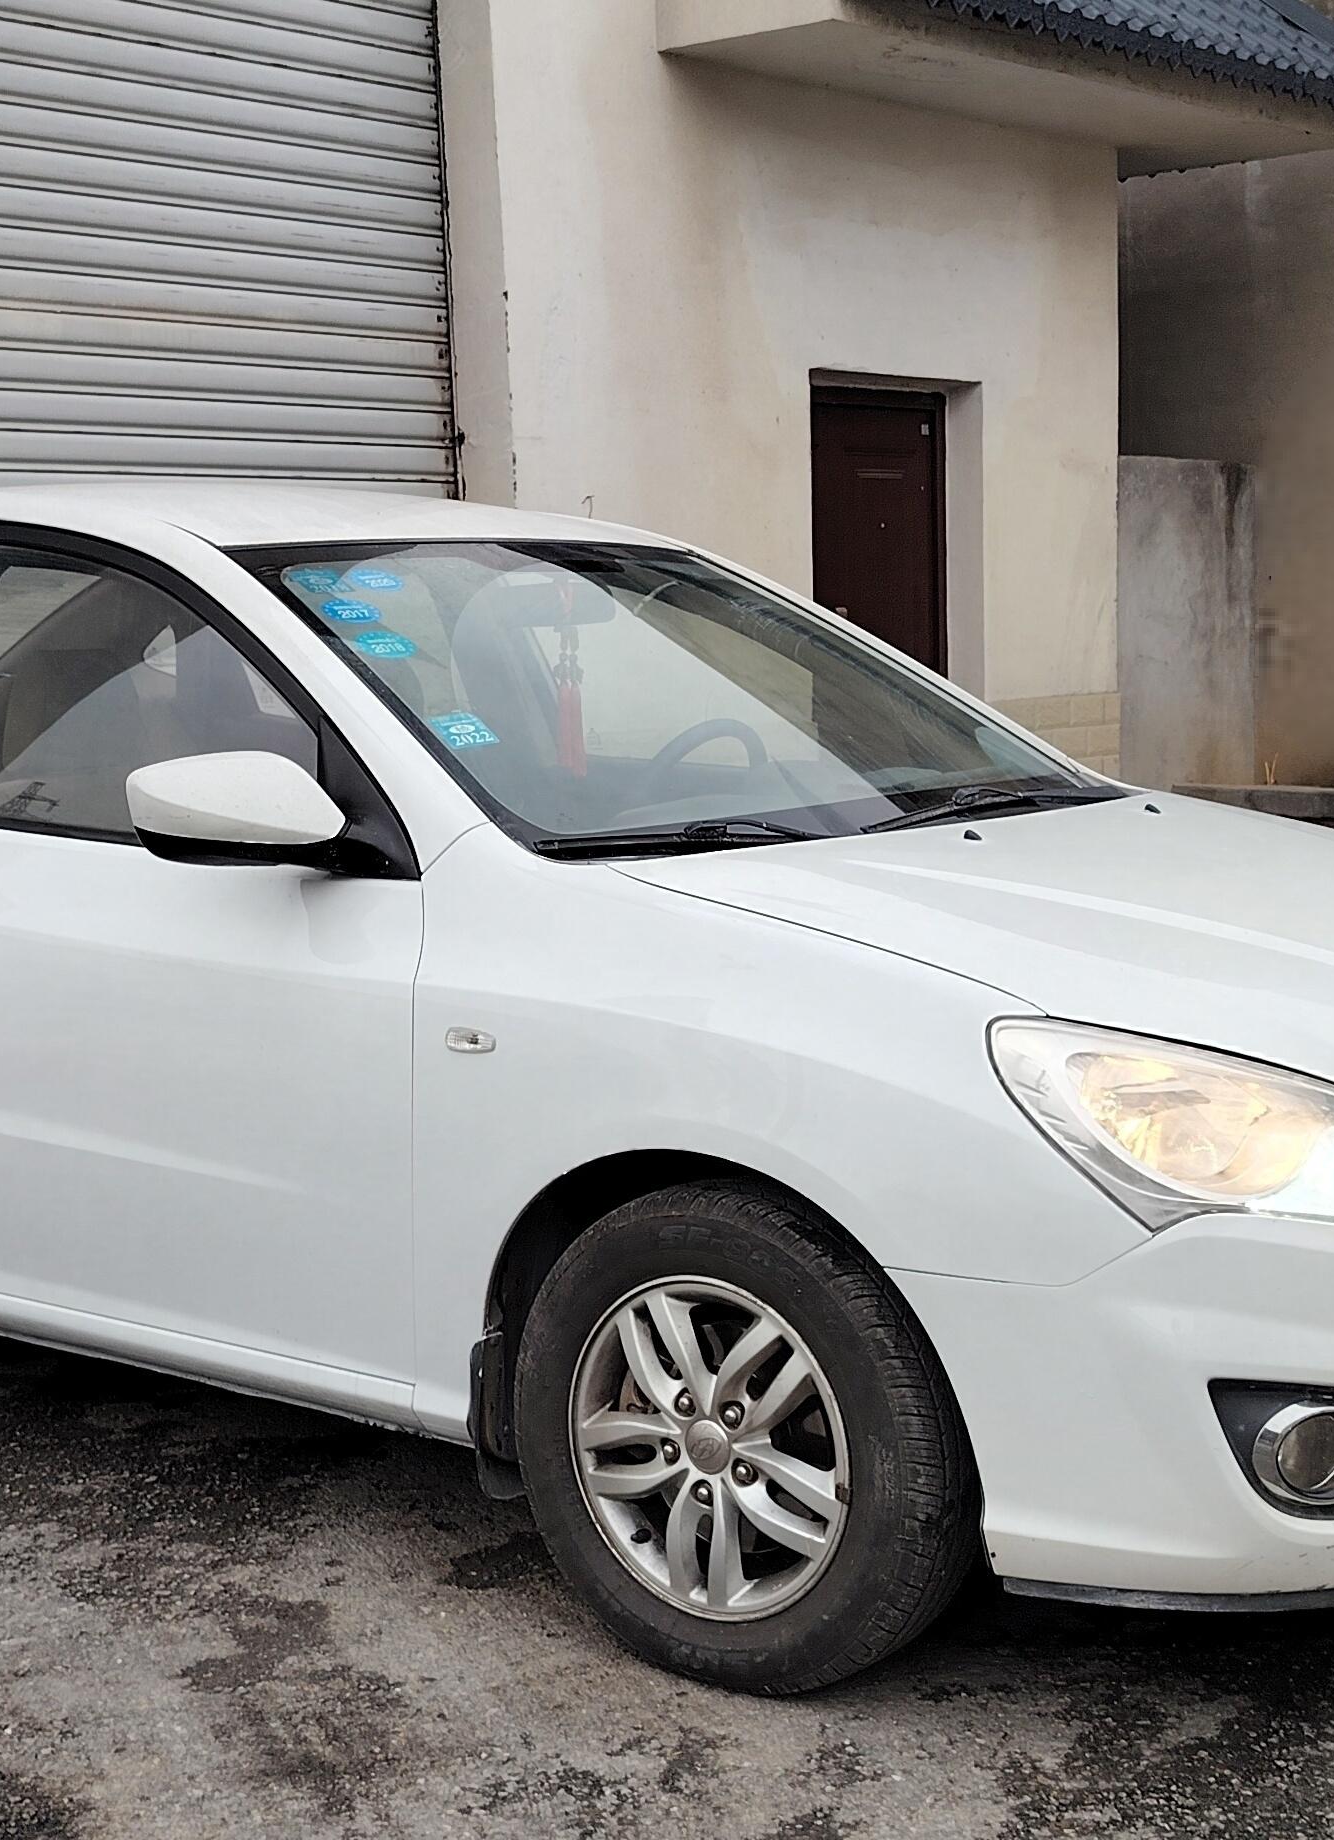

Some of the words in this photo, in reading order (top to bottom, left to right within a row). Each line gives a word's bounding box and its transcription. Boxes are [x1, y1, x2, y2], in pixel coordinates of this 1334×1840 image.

[337, 609, 370, 619] 2017
[371, 643, 407, 654] 2018
[450, 731, 495, 747] 2022
